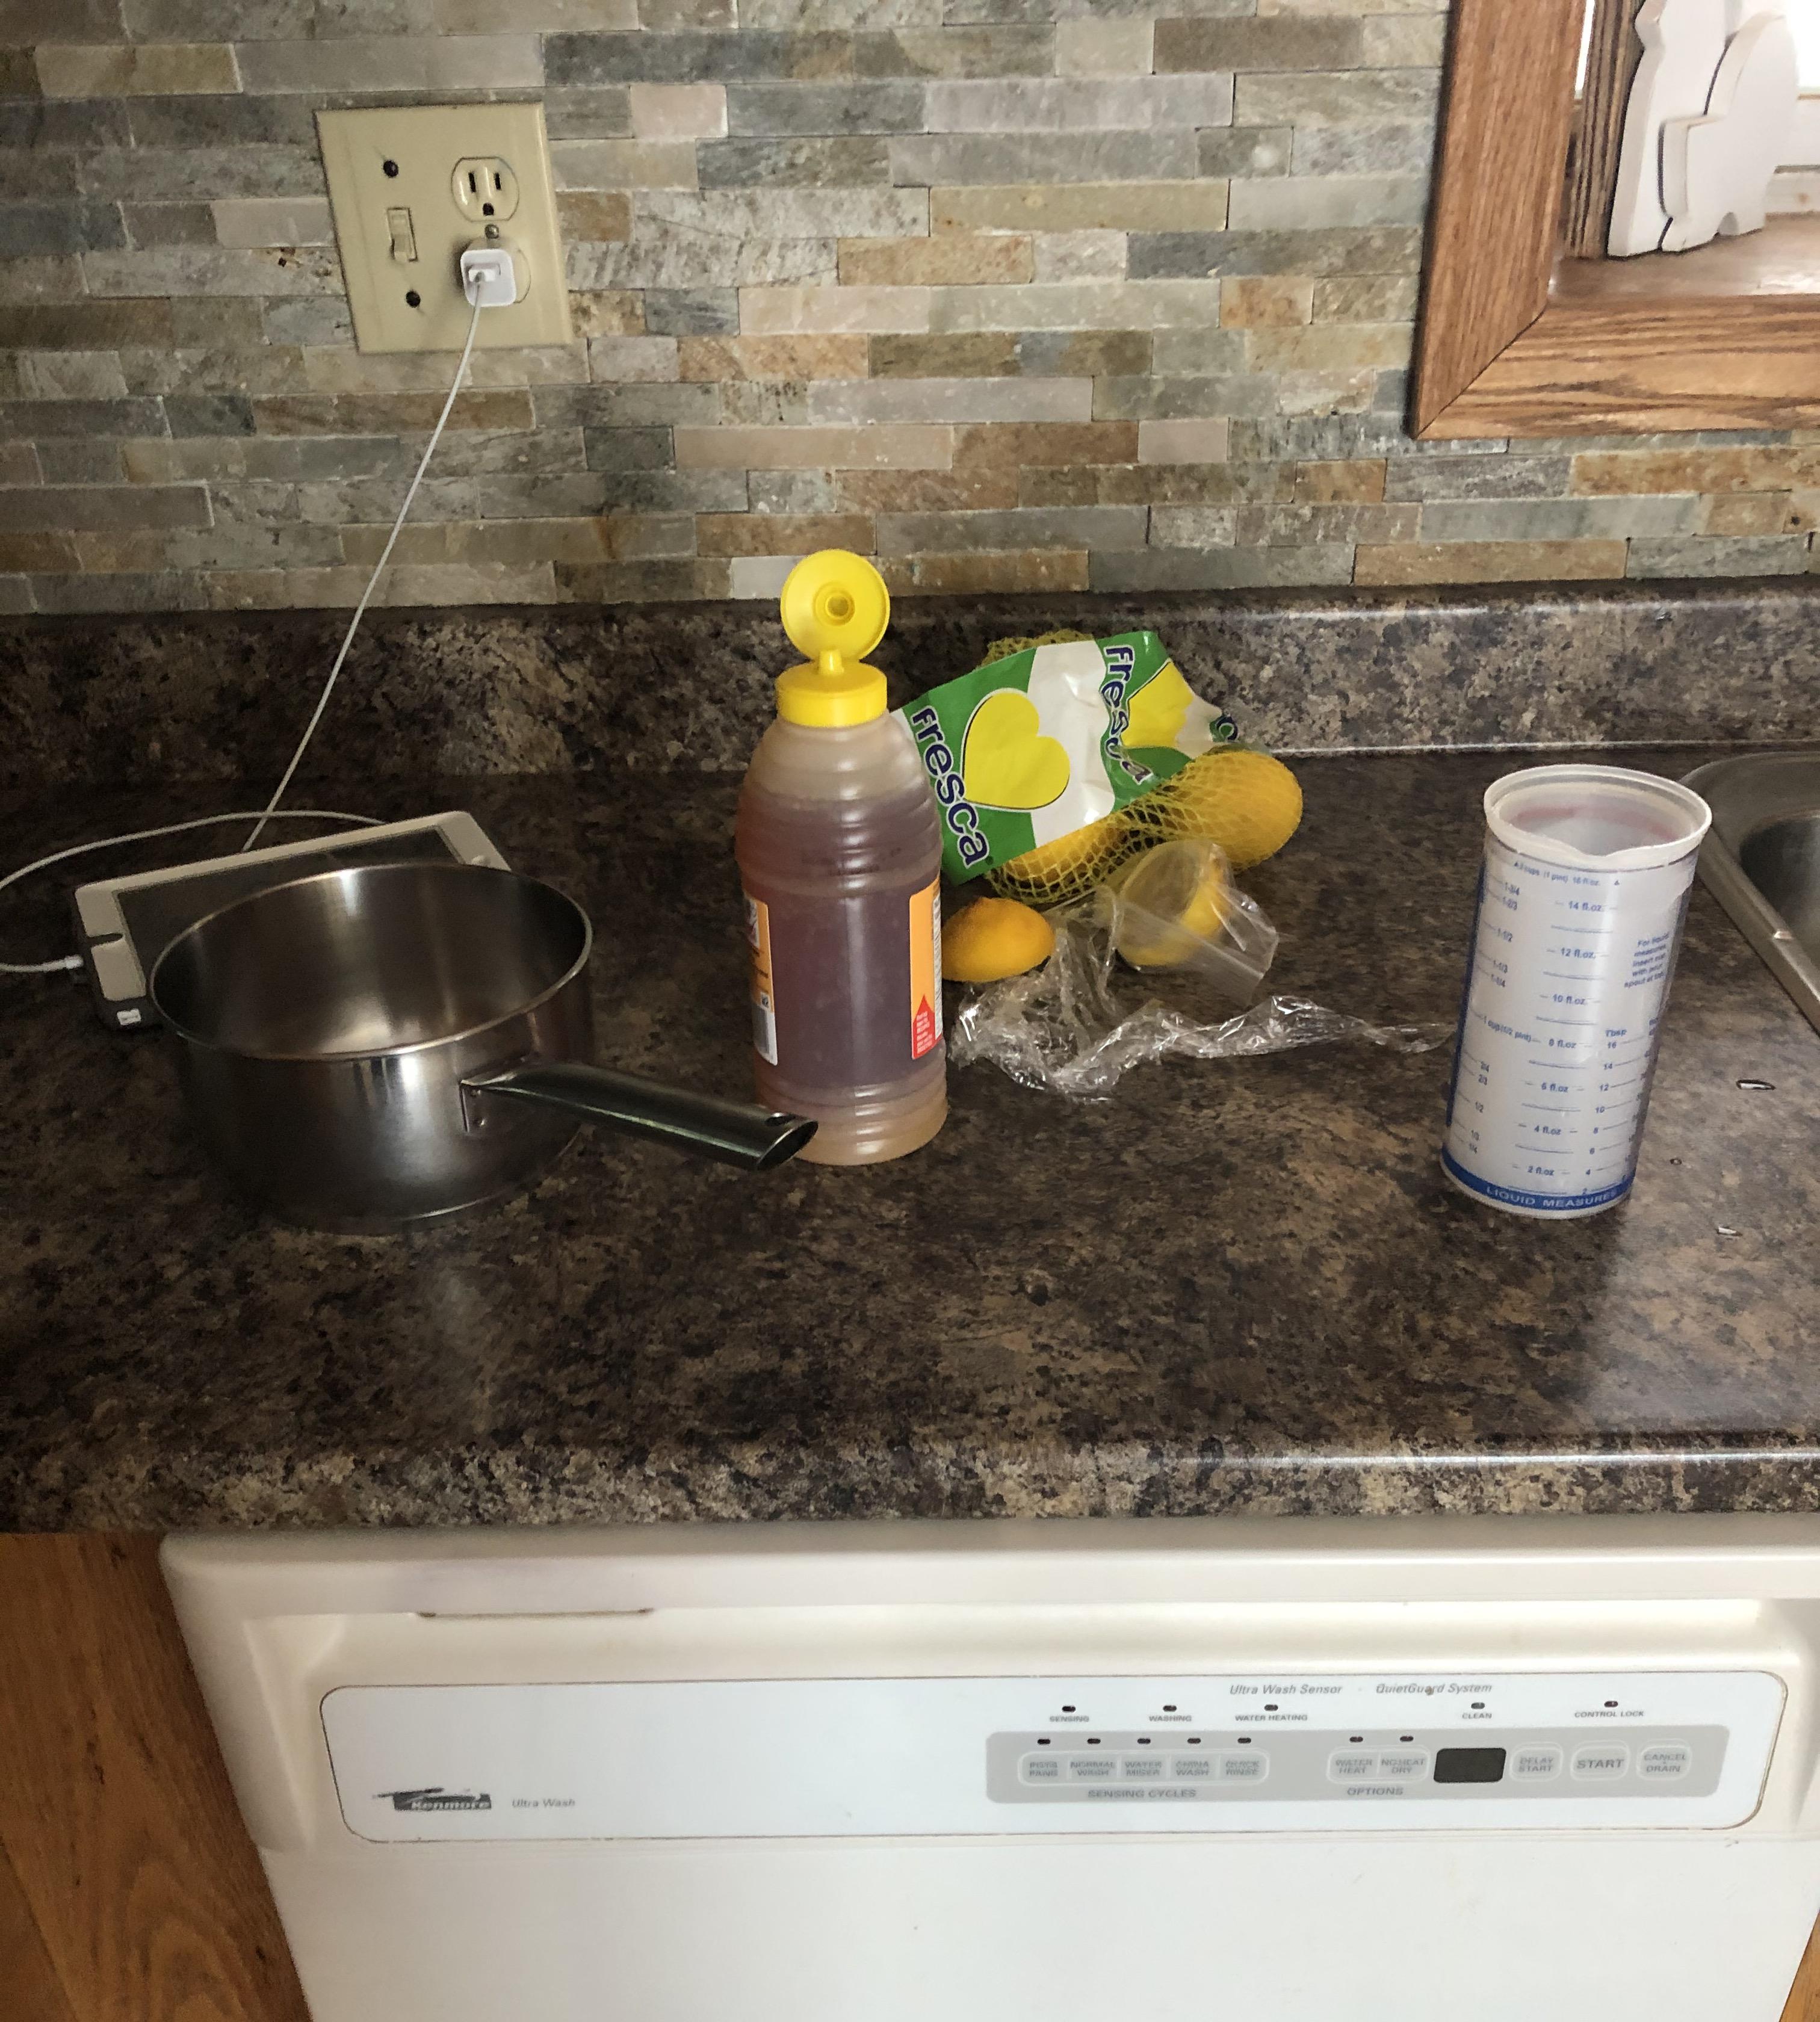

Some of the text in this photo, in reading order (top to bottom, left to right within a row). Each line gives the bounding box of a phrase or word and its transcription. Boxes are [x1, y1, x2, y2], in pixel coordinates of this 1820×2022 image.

[1568, 901, 1579, 909] 14
[1561, 947, 1571, 957] 12
[1553, 994, 1563, 1003] 10
[1549, 1039, 1555, 1047] 8
[1487, 1186, 1618, 1207] LIQUID MEASURES
[1230, 1684, 1343, 1695] Ultra Wash Sensor
[1375, 1684, 1492, 1695] QuietGuard System
[1577, 1759, 1624, 1769] START
[1088, 1789, 1196, 1798] SENSING CYCLES
[1347, 1787, 1404, 1796] OPTIONS
[512, 1799, 539, 1807] Ultra
[542, 1799, 575, 1807] Wash
